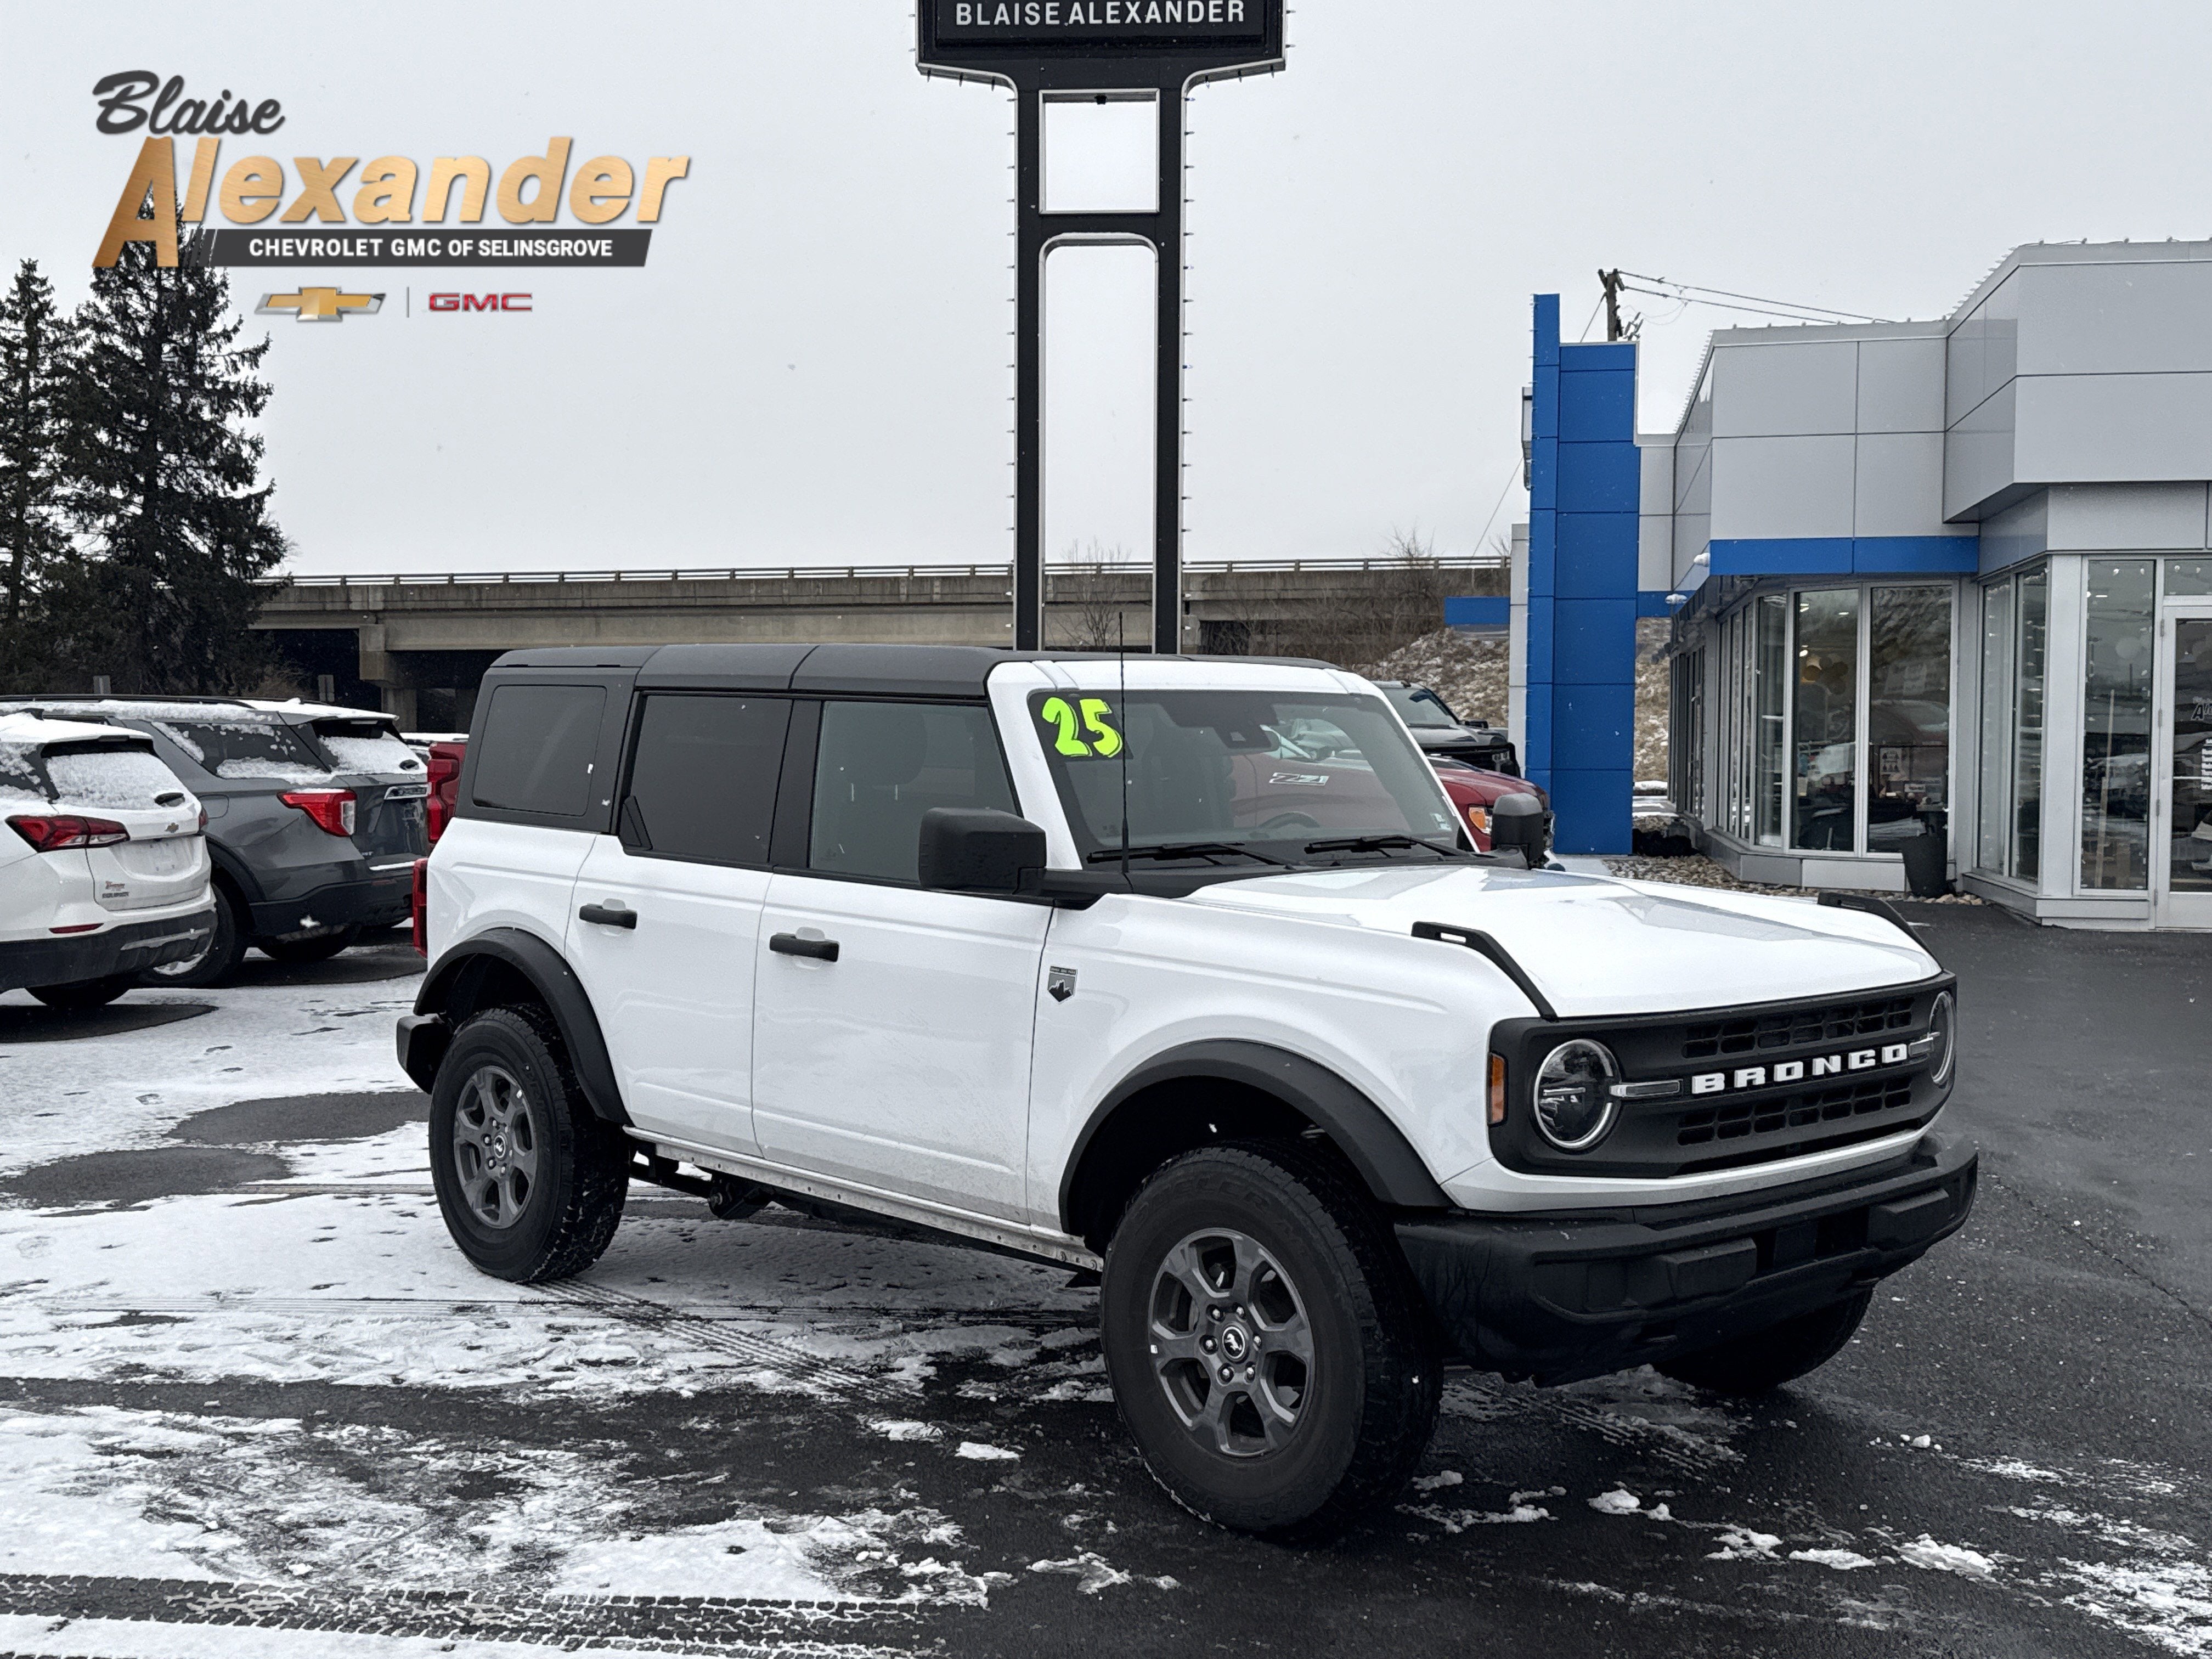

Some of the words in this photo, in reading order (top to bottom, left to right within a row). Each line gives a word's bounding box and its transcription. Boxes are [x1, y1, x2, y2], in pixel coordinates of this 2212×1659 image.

[956, 2, 1060, 26] BLAISE
[1067, 0, 1244, 25] ALEXANDER
[1042, 697, 1123, 758] 25
[1691, 1043, 1908, 1094] BRONCO
